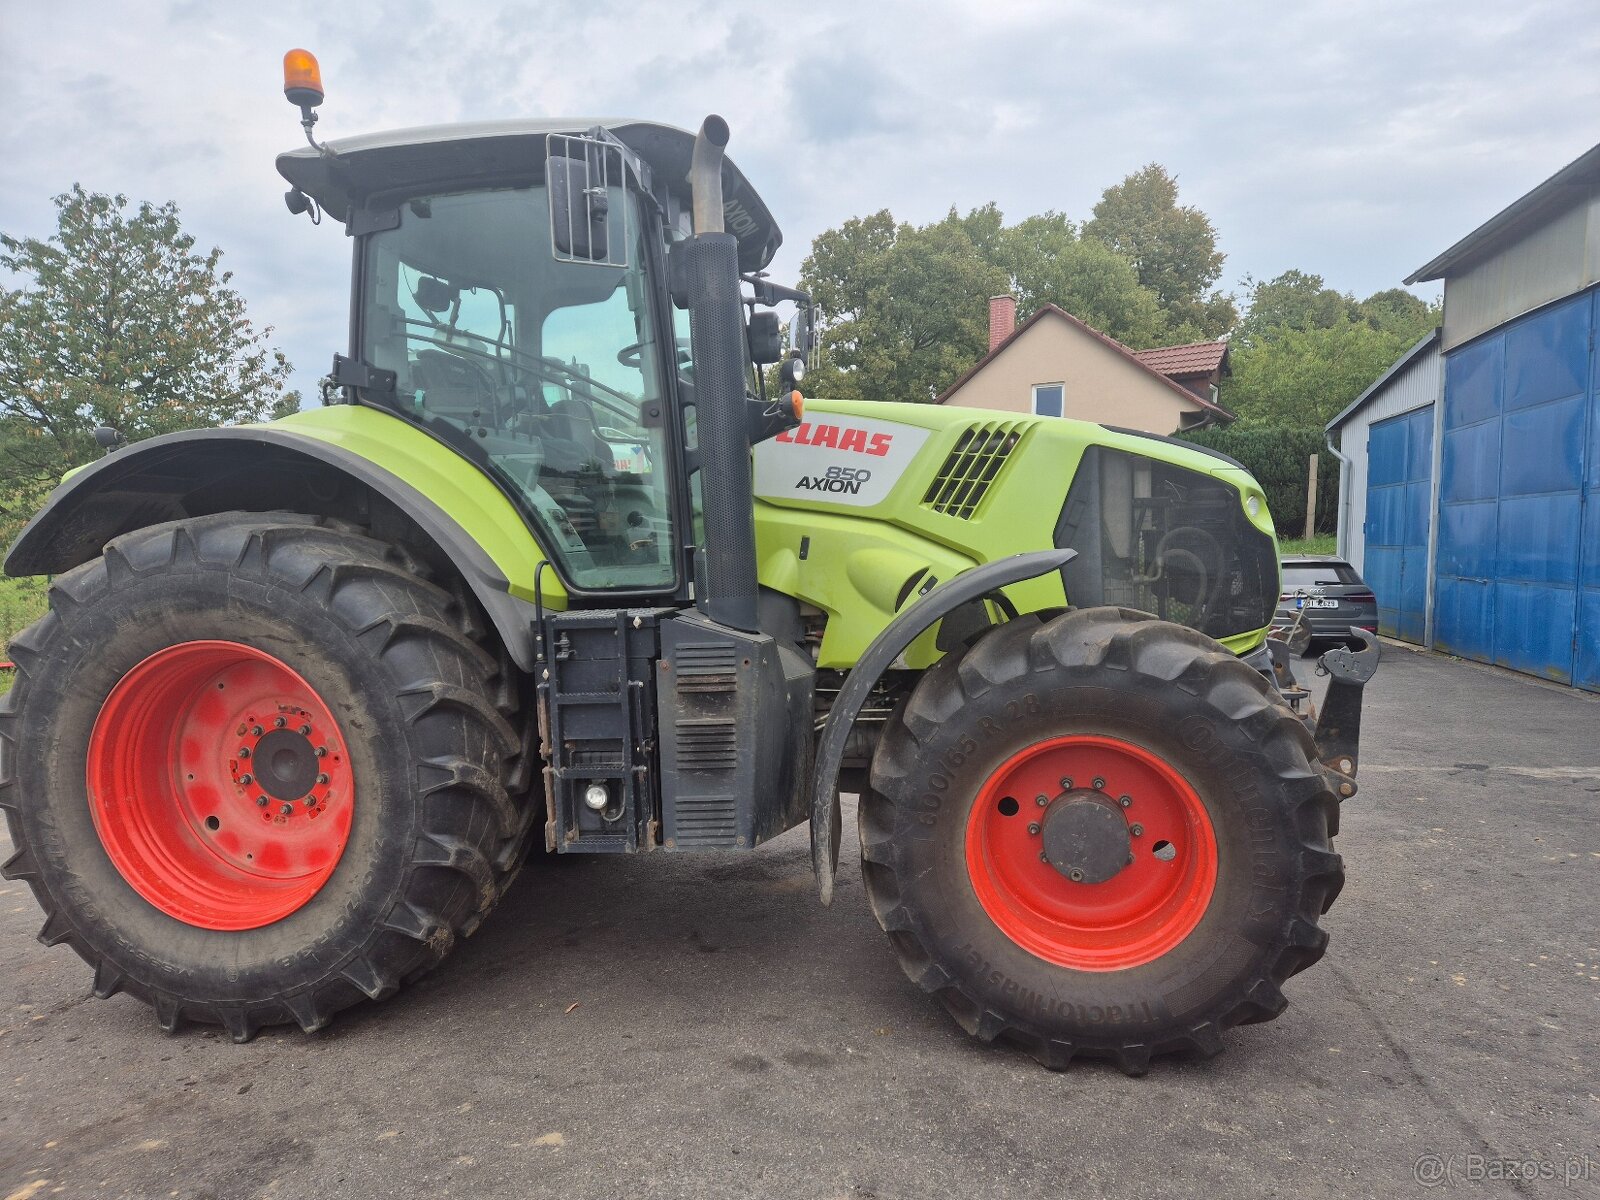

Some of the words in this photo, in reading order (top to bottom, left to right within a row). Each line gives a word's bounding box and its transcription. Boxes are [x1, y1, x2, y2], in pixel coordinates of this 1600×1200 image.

[724, 199, 760, 241] AXION
[825, 466, 872, 483] 850
[795, 476, 861, 495] AXION
